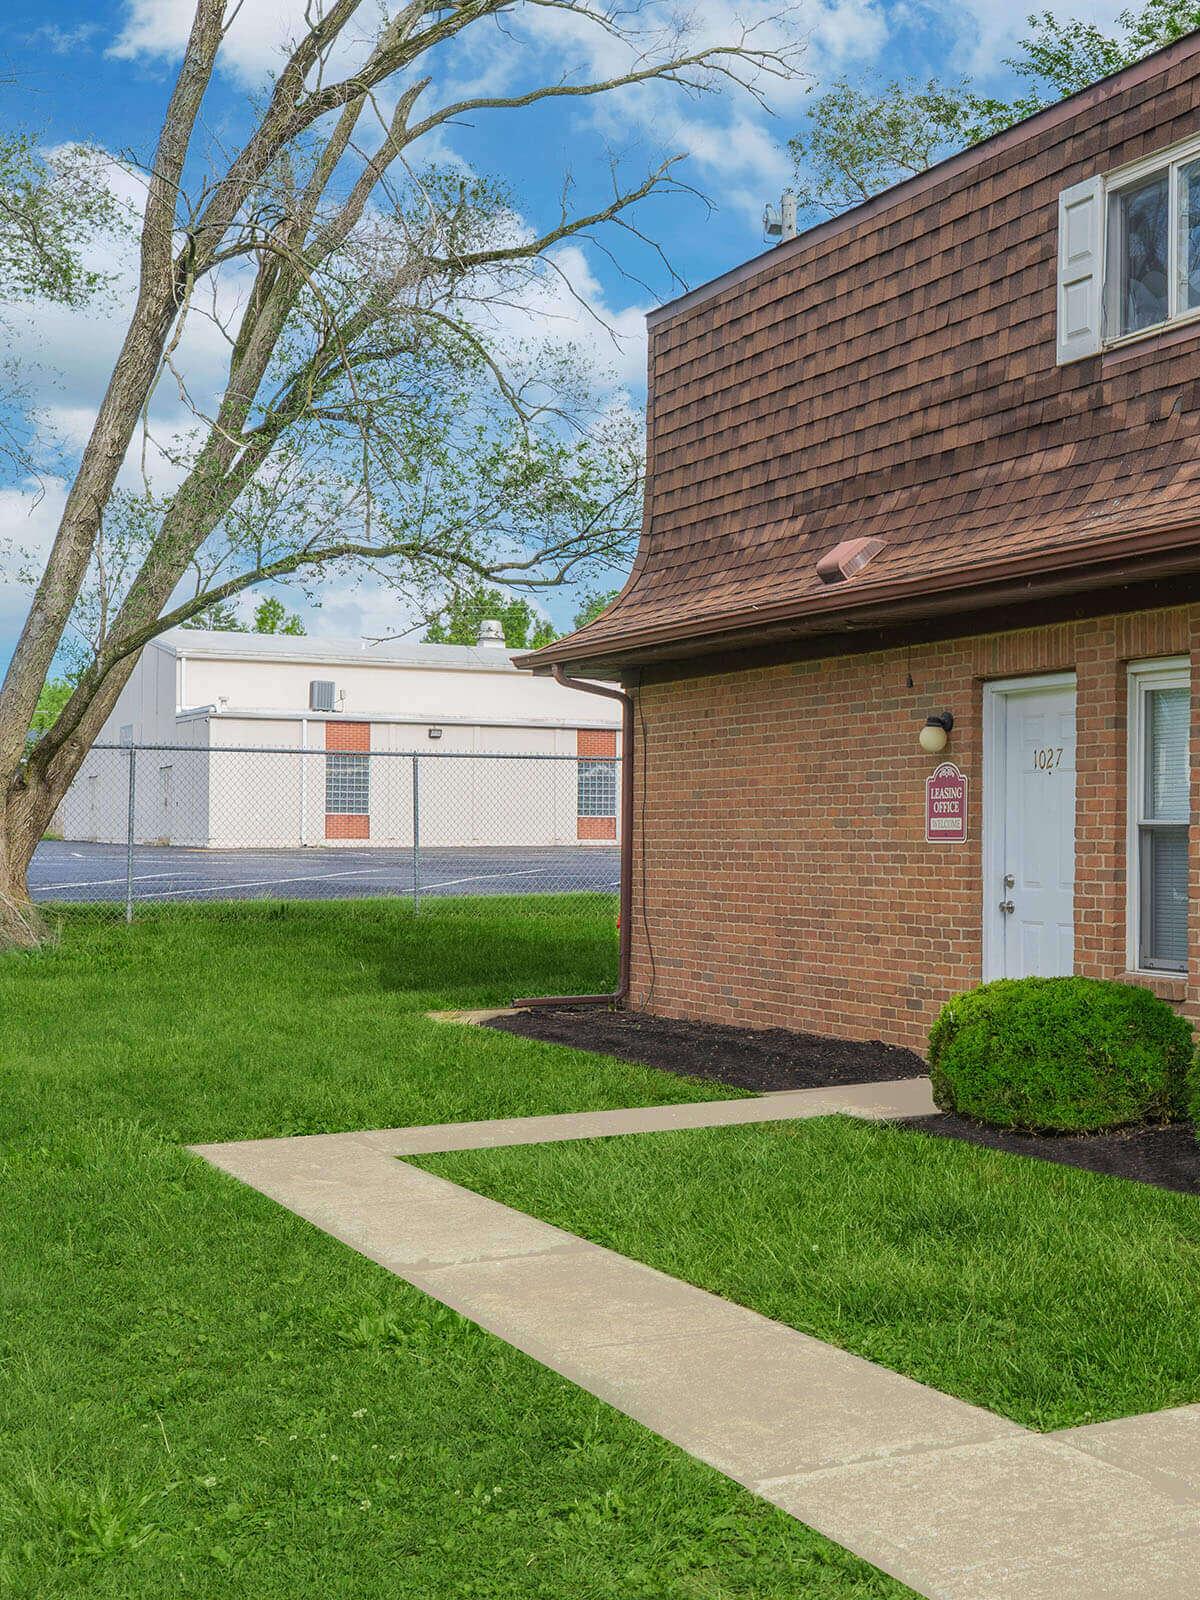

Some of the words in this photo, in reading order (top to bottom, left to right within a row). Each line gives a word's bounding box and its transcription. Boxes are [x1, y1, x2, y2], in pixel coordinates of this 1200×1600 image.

[1034, 748, 1063, 769] 1027
[930, 786, 962, 799] LEASING
[933, 801, 960, 813] OFFICE
